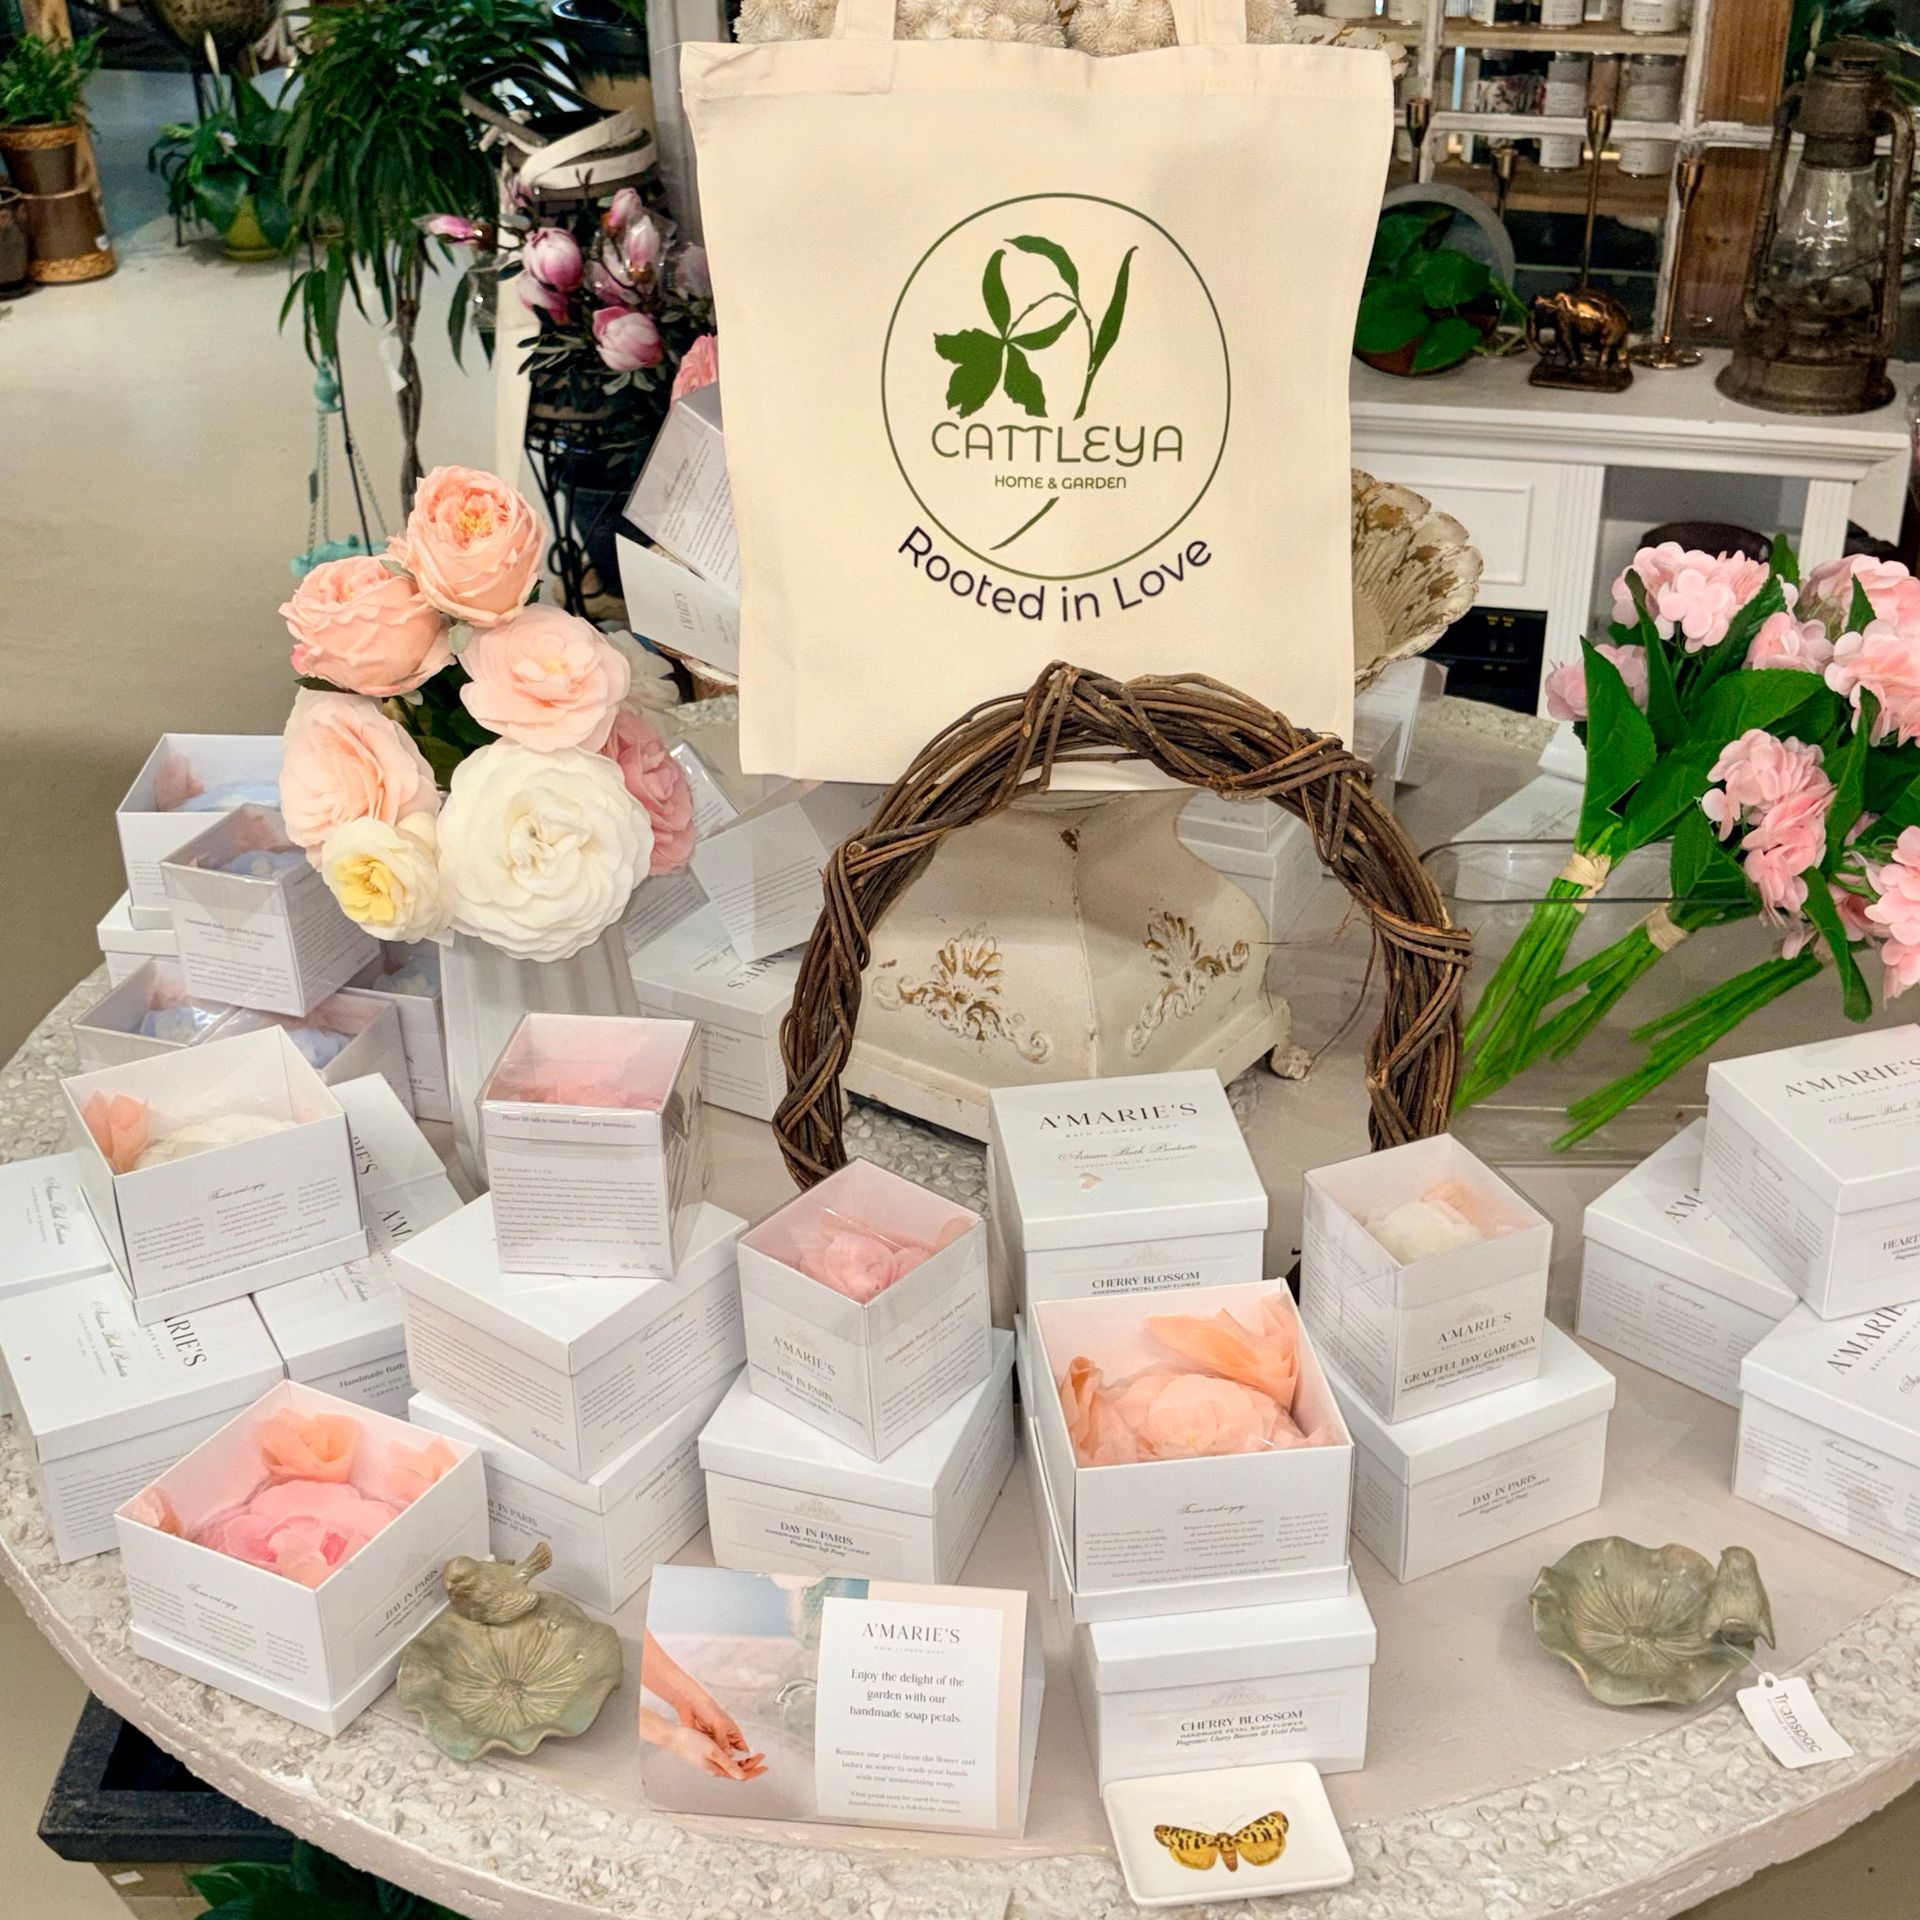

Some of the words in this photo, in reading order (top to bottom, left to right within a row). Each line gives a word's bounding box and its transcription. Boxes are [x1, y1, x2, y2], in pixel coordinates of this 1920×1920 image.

[931, 421, 1183, 467] CATTLEYA
[994, 475, 1044, 489] HOME
[1047, 477, 1058, 489] &
[1061, 476, 1127, 489] GARDEN
[898, 526, 1045, 621] Rooted
[1061, 585, 1100, 622] in
[1113, 539, 1212, 610] Love
[1039, 1102, 1198, 1130] A'MARIE'S
[1091, 1276, 1139, 1289] CHERRY
[1143, 1271, 1200, 1285] BLOSSOM
[1437, 1312, 1512, 1344] A'MARIE'S
[164, 1317, 207, 1367] RIE'S
[1827, 1305, 1907, 1375] A'MARIE
[1404, 1360, 1457, 1385] GRACEFUL
[1460, 1352, 1482, 1367] DAY
[1508, 1473, 1537, 1491] PARIS
[780, 1521, 801, 1534] DAY
[805, 1527, 818, 1538] IN
[820, 1531, 854, 1546] PARIS
[862, 1622, 961, 1644] A'MARIE'S
[851, 1669, 878, 1683] Enjoy
[881, 1670, 897, 1682] the
[899, 1671, 933, 1687] delight
[936, 1674, 948, 1687] of
[949, 1675, 965, 1688] the
[866, 1690, 902, 1702] garden
[904, 1691, 926, 1703] with
[929, 1694, 948, 1704] our
[850, 1705, 902, 1719] handmade
[904, 1711, 928, 1724] soap
[1181, 1717, 1234, 1732] CHERRY
[1239, 1709, 1303, 1726] BLOSSOM
[835, 1747, 865, 1757] Remove
[867, 1751, 881, 1759] one
[882, 1752, 902, 1762] petal
[903, 1753, 921, 1762] from
[922, 1754, 935, 1763] the
[935, 1755, 959, 1765] flower
[961, 1757, 976, 1766] and
[874, 1763, 895, 1771] water
[897, 1764, 905, 1772] to
[927, 1767, 945, 1776] your
[945, 1768, 969, 1777] hands
